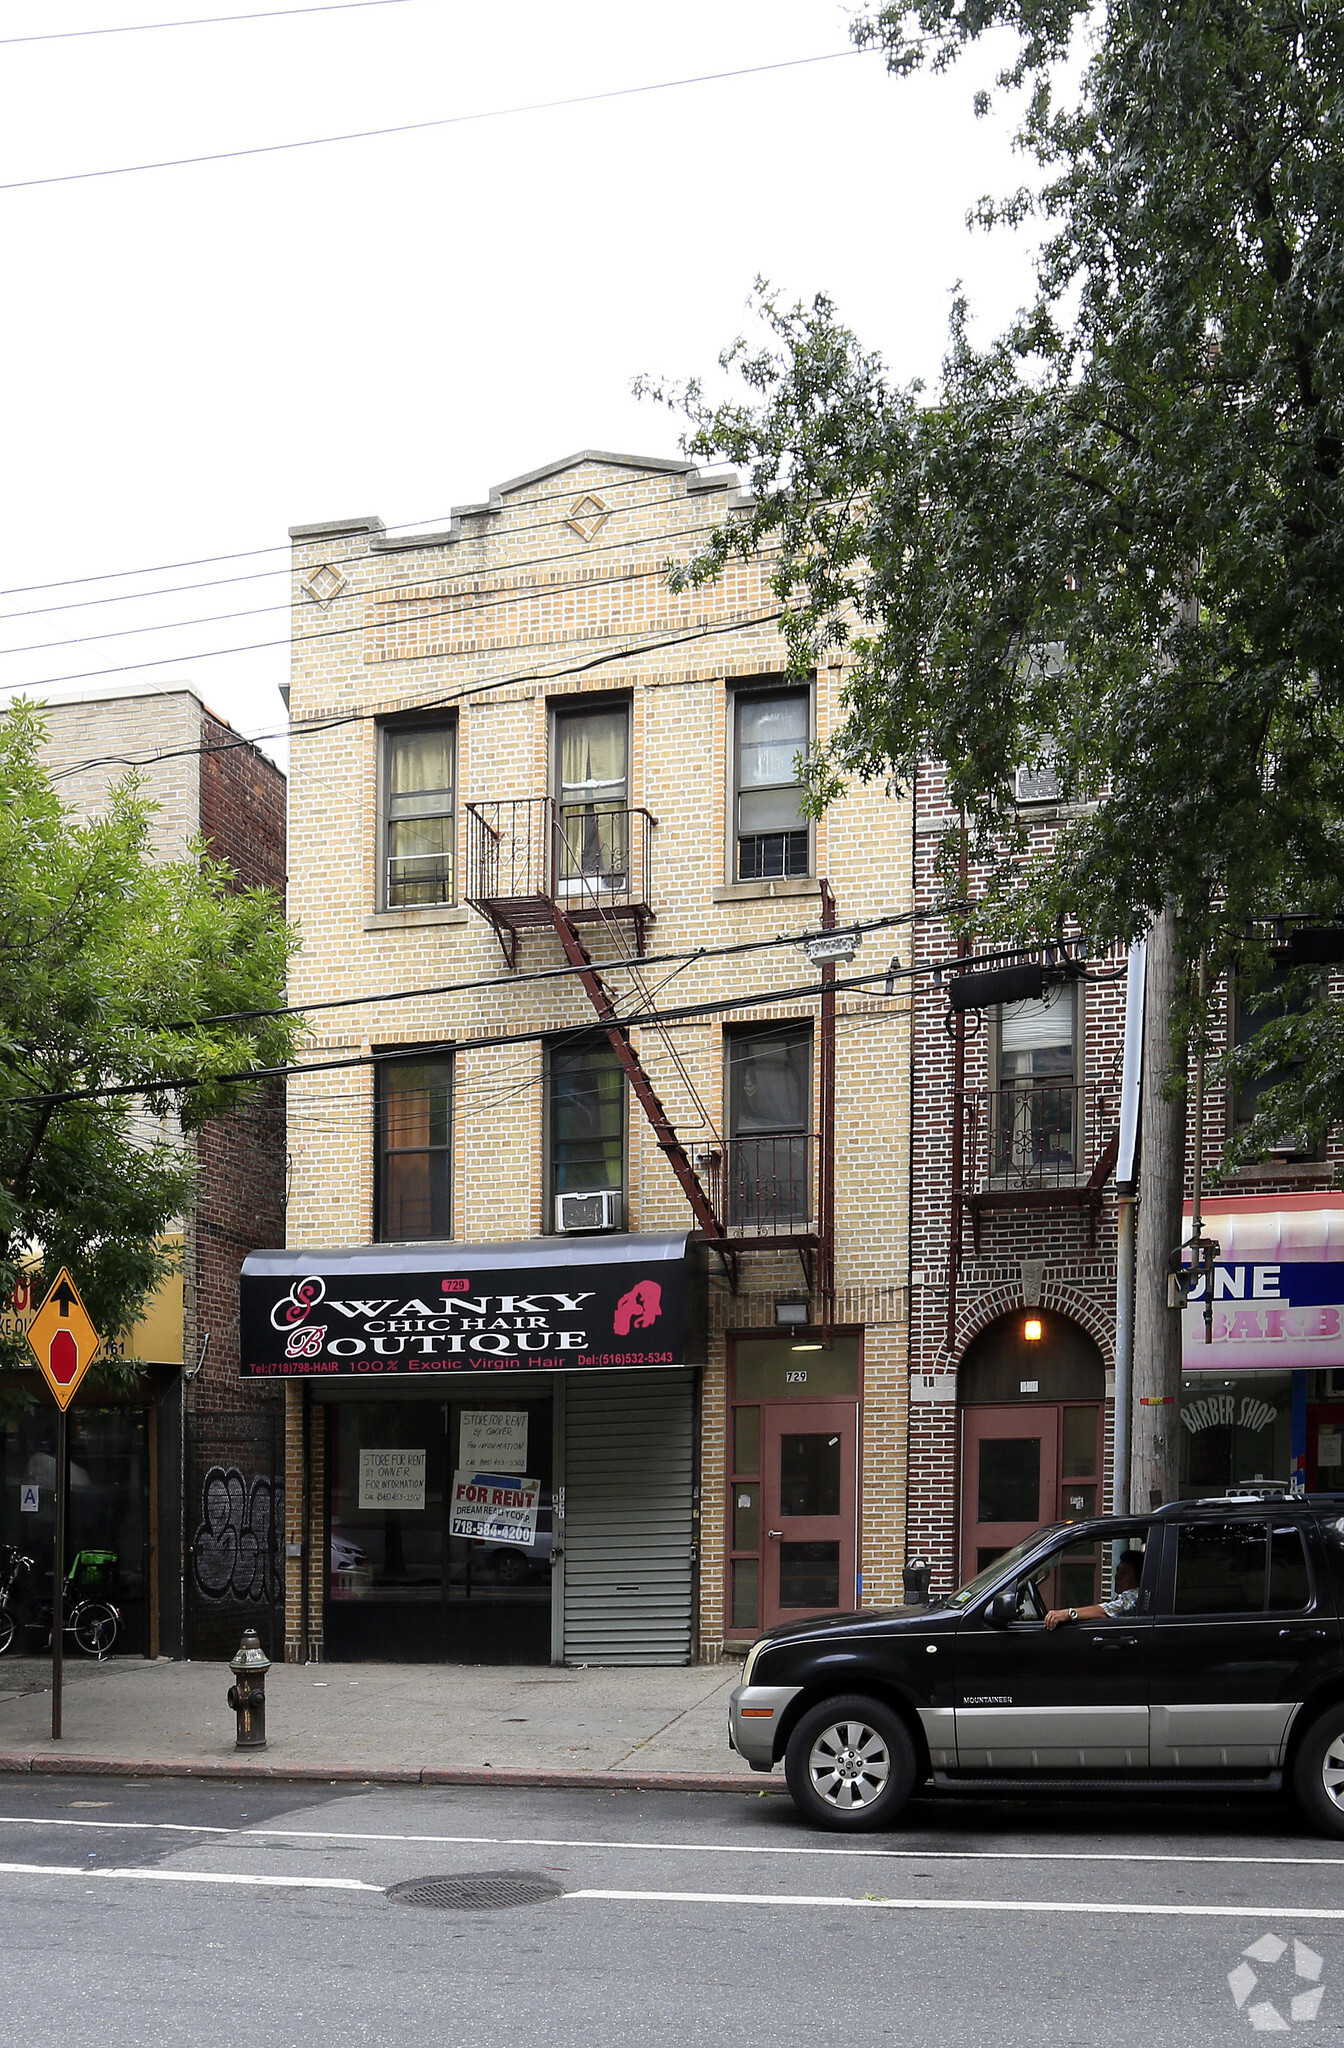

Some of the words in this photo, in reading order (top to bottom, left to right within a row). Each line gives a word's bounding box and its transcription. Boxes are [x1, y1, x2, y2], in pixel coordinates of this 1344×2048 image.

[446, 1279, 465, 1291] 729
[271, 1276, 596, 1332] SWANKY
[363, 1317, 440, 1333] CHIC
[460, 1315, 549, 1330] HAIR
[285, 1325, 590, 1358] BOUTIQUE
[349, 1360, 399, 1372] 100%
[409, 1359, 462, 1370] Exotic
[469, 1357, 520, 1370] Virgin
[528, 1356, 566, 1368] Hair
[577, 1352, 674, 1367] Del:(516)532-5343
[250, 1361, 339, 1374] Tel:(718)798-HAIR
[787, 1372, 806, 1382] 729
[463, 1415, 488, 1426] STORE
[489, 1415, 503, 1426] FOR
[505, 1415, 527, 1426] RENT
[1180, 1395, 1235, 1434] BARBER
[1236, 1397, 1279, 1432] SHOP
[486, 1427, 513, 1436] OWNER
[478, 1442, 525, 1450] INFORMATION
[363, 1454, 389, 1466] STORE
[391, 1454, 406, 1466] FOR
[407, 1454, 425, 1466] RENT
[377, 1467, 410, 1476] OWNER
[365, 1480, 380, 1489] FOR
[382, 1479, 424, 1488] INFORMATION
[24, 1488, 36, 1504] A
[456, 1484, 488, 1504] FOR
[492, 1488, 535, 1508] RENT
[456, 1506, 483, 1515] DREAM
[454, 1519, 530, 1541] 718-584-4200
[963, 1696, 1013, 1704] MOUNTAINEER
